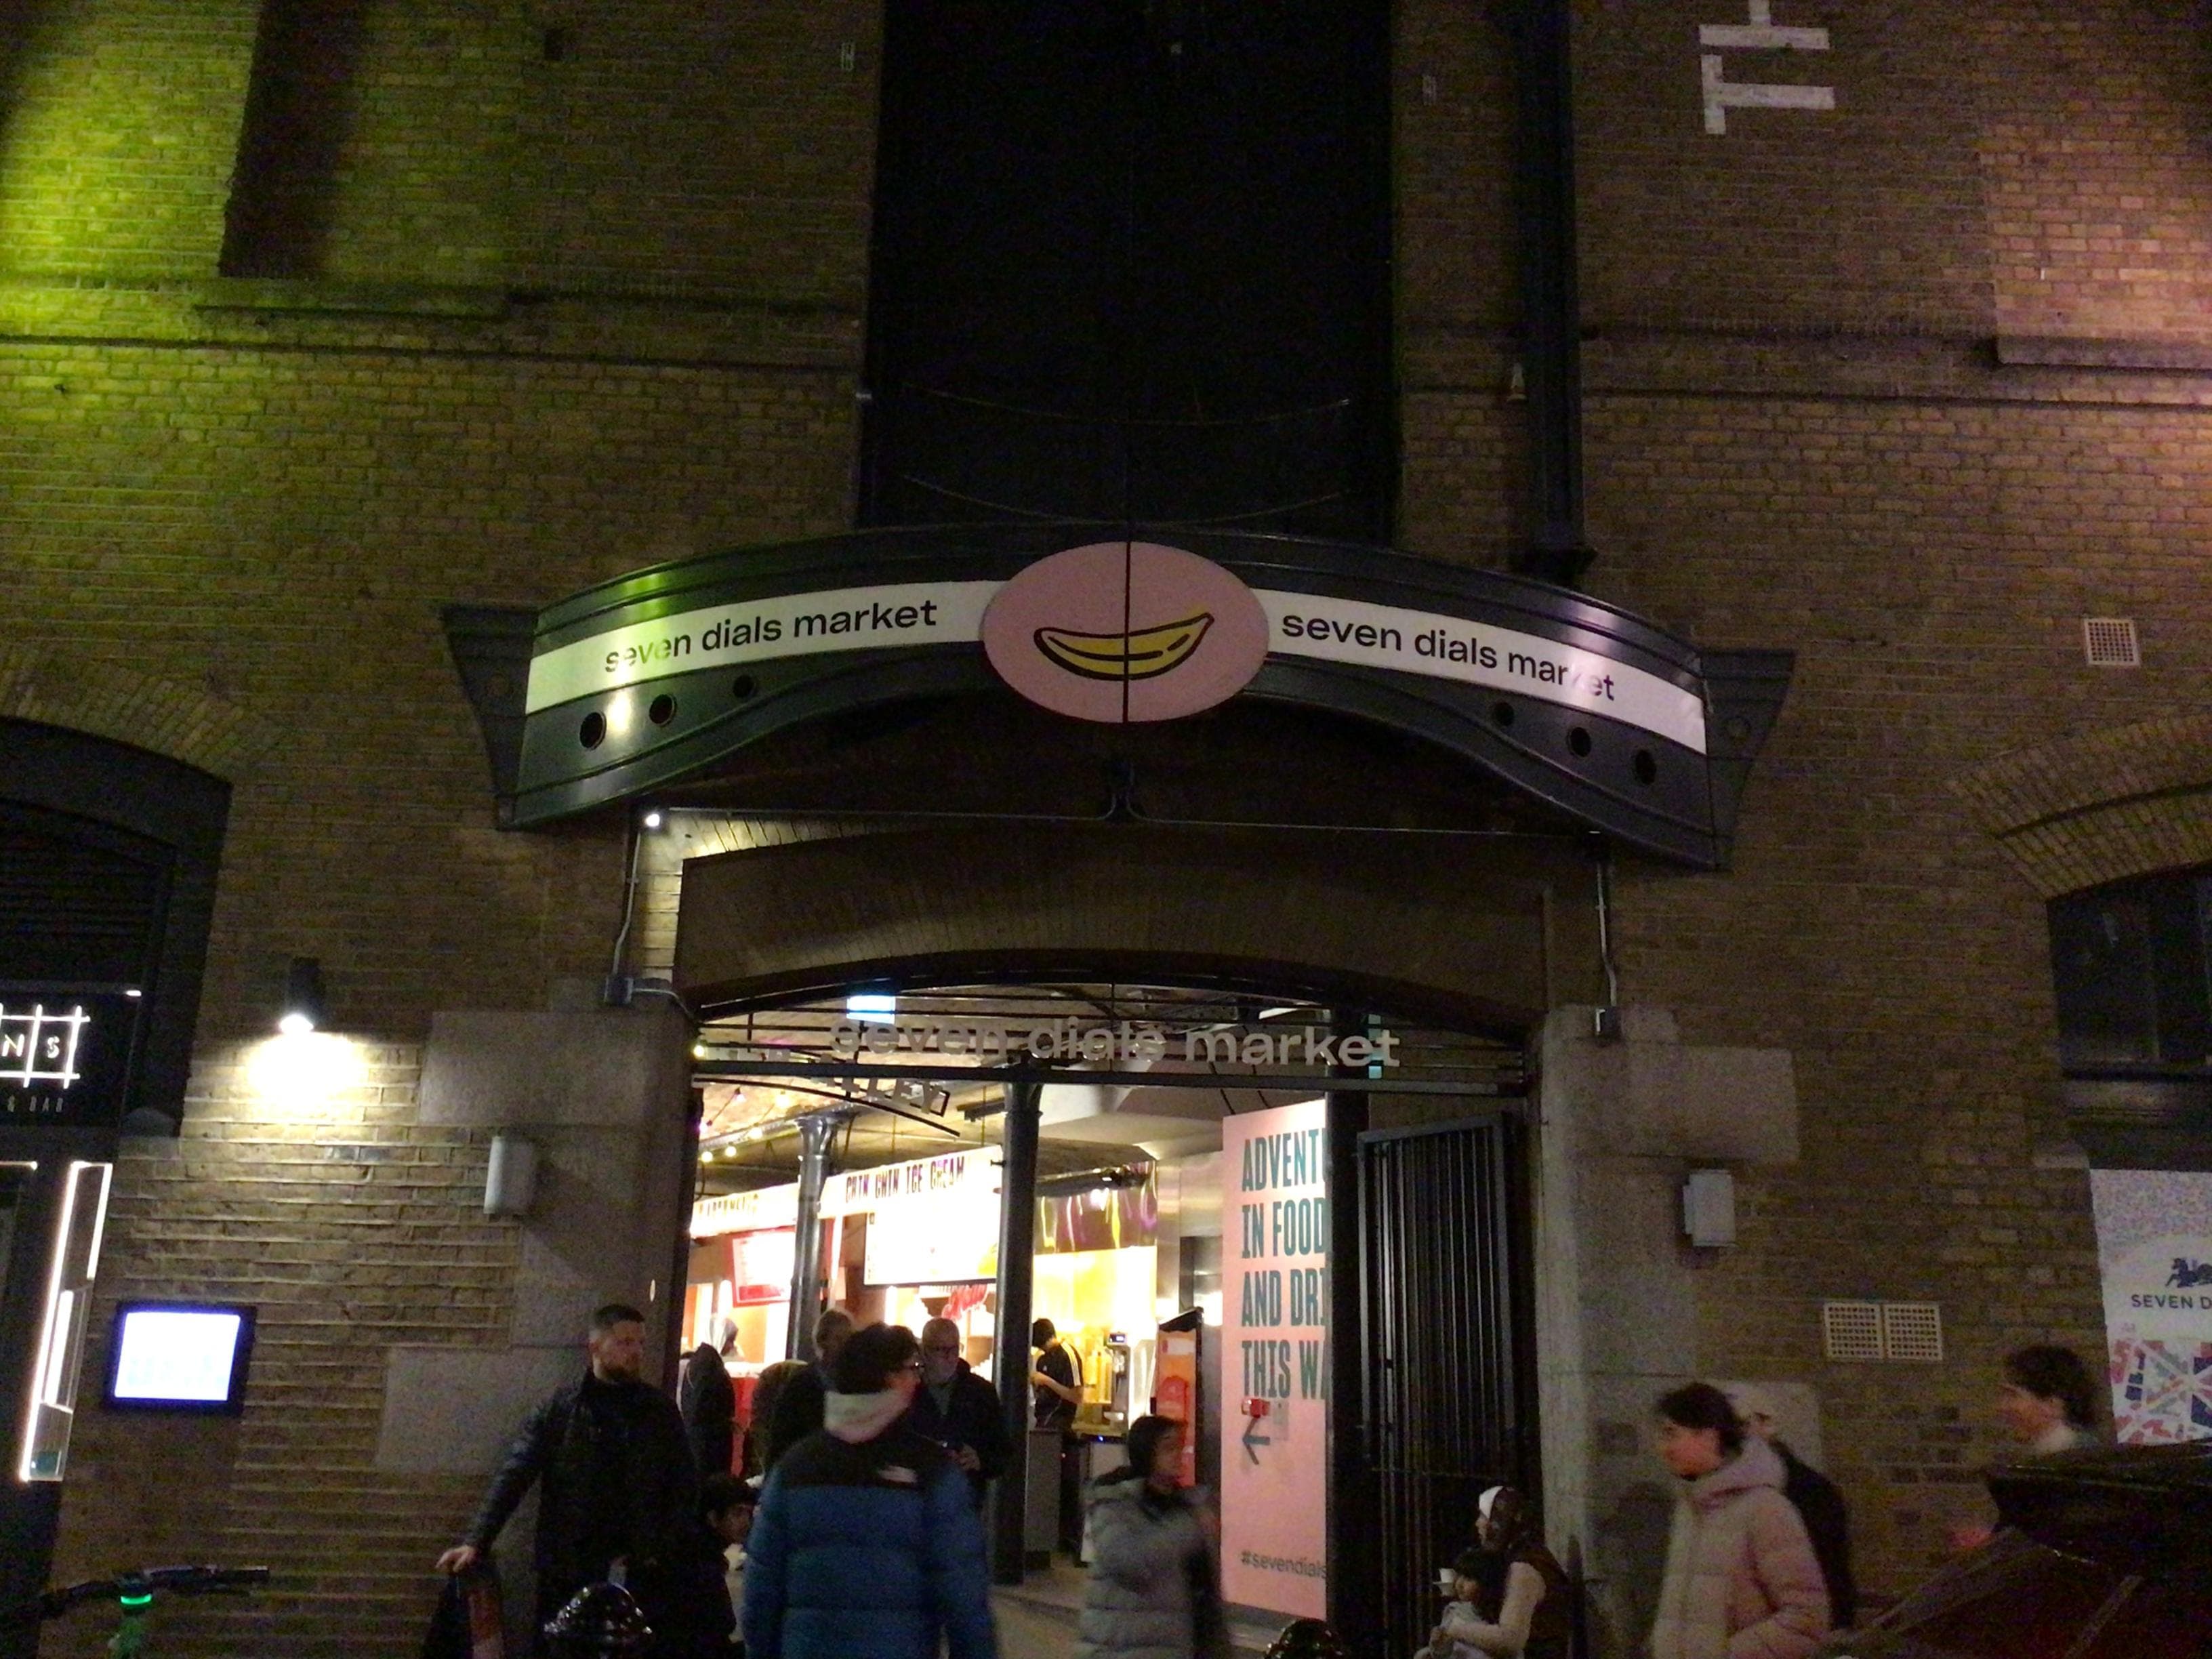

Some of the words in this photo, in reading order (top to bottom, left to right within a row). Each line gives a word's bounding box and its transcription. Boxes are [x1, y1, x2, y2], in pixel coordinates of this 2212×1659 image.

[605, 634, 691, 672] seven
[702, 615, 781, 651] dials
[794, 600, 938, 638] market
[1282, 613, 1402, 651] seven
[1414, 630, 1497, 670] dials
[1509, 652, 1614, 701] maret
[830, 1021, 1008, 1056] seven
[1027, 1017, 1166, 1063] dials
[1187, 1025, 1401, 1067] market
[28, 1095, 64, 1113] BAR
[905, 1164, 924, 1194] ICE
[1242, 1202, 1265, 1259] IN
[1273, 1197, 1326, 1257] FOOD
[1242, 1269, 1282, 1328] AND
[2131, 1294, 2194, 1309] SEVEN
[1242, 1339, 1291, 1399] THIS
